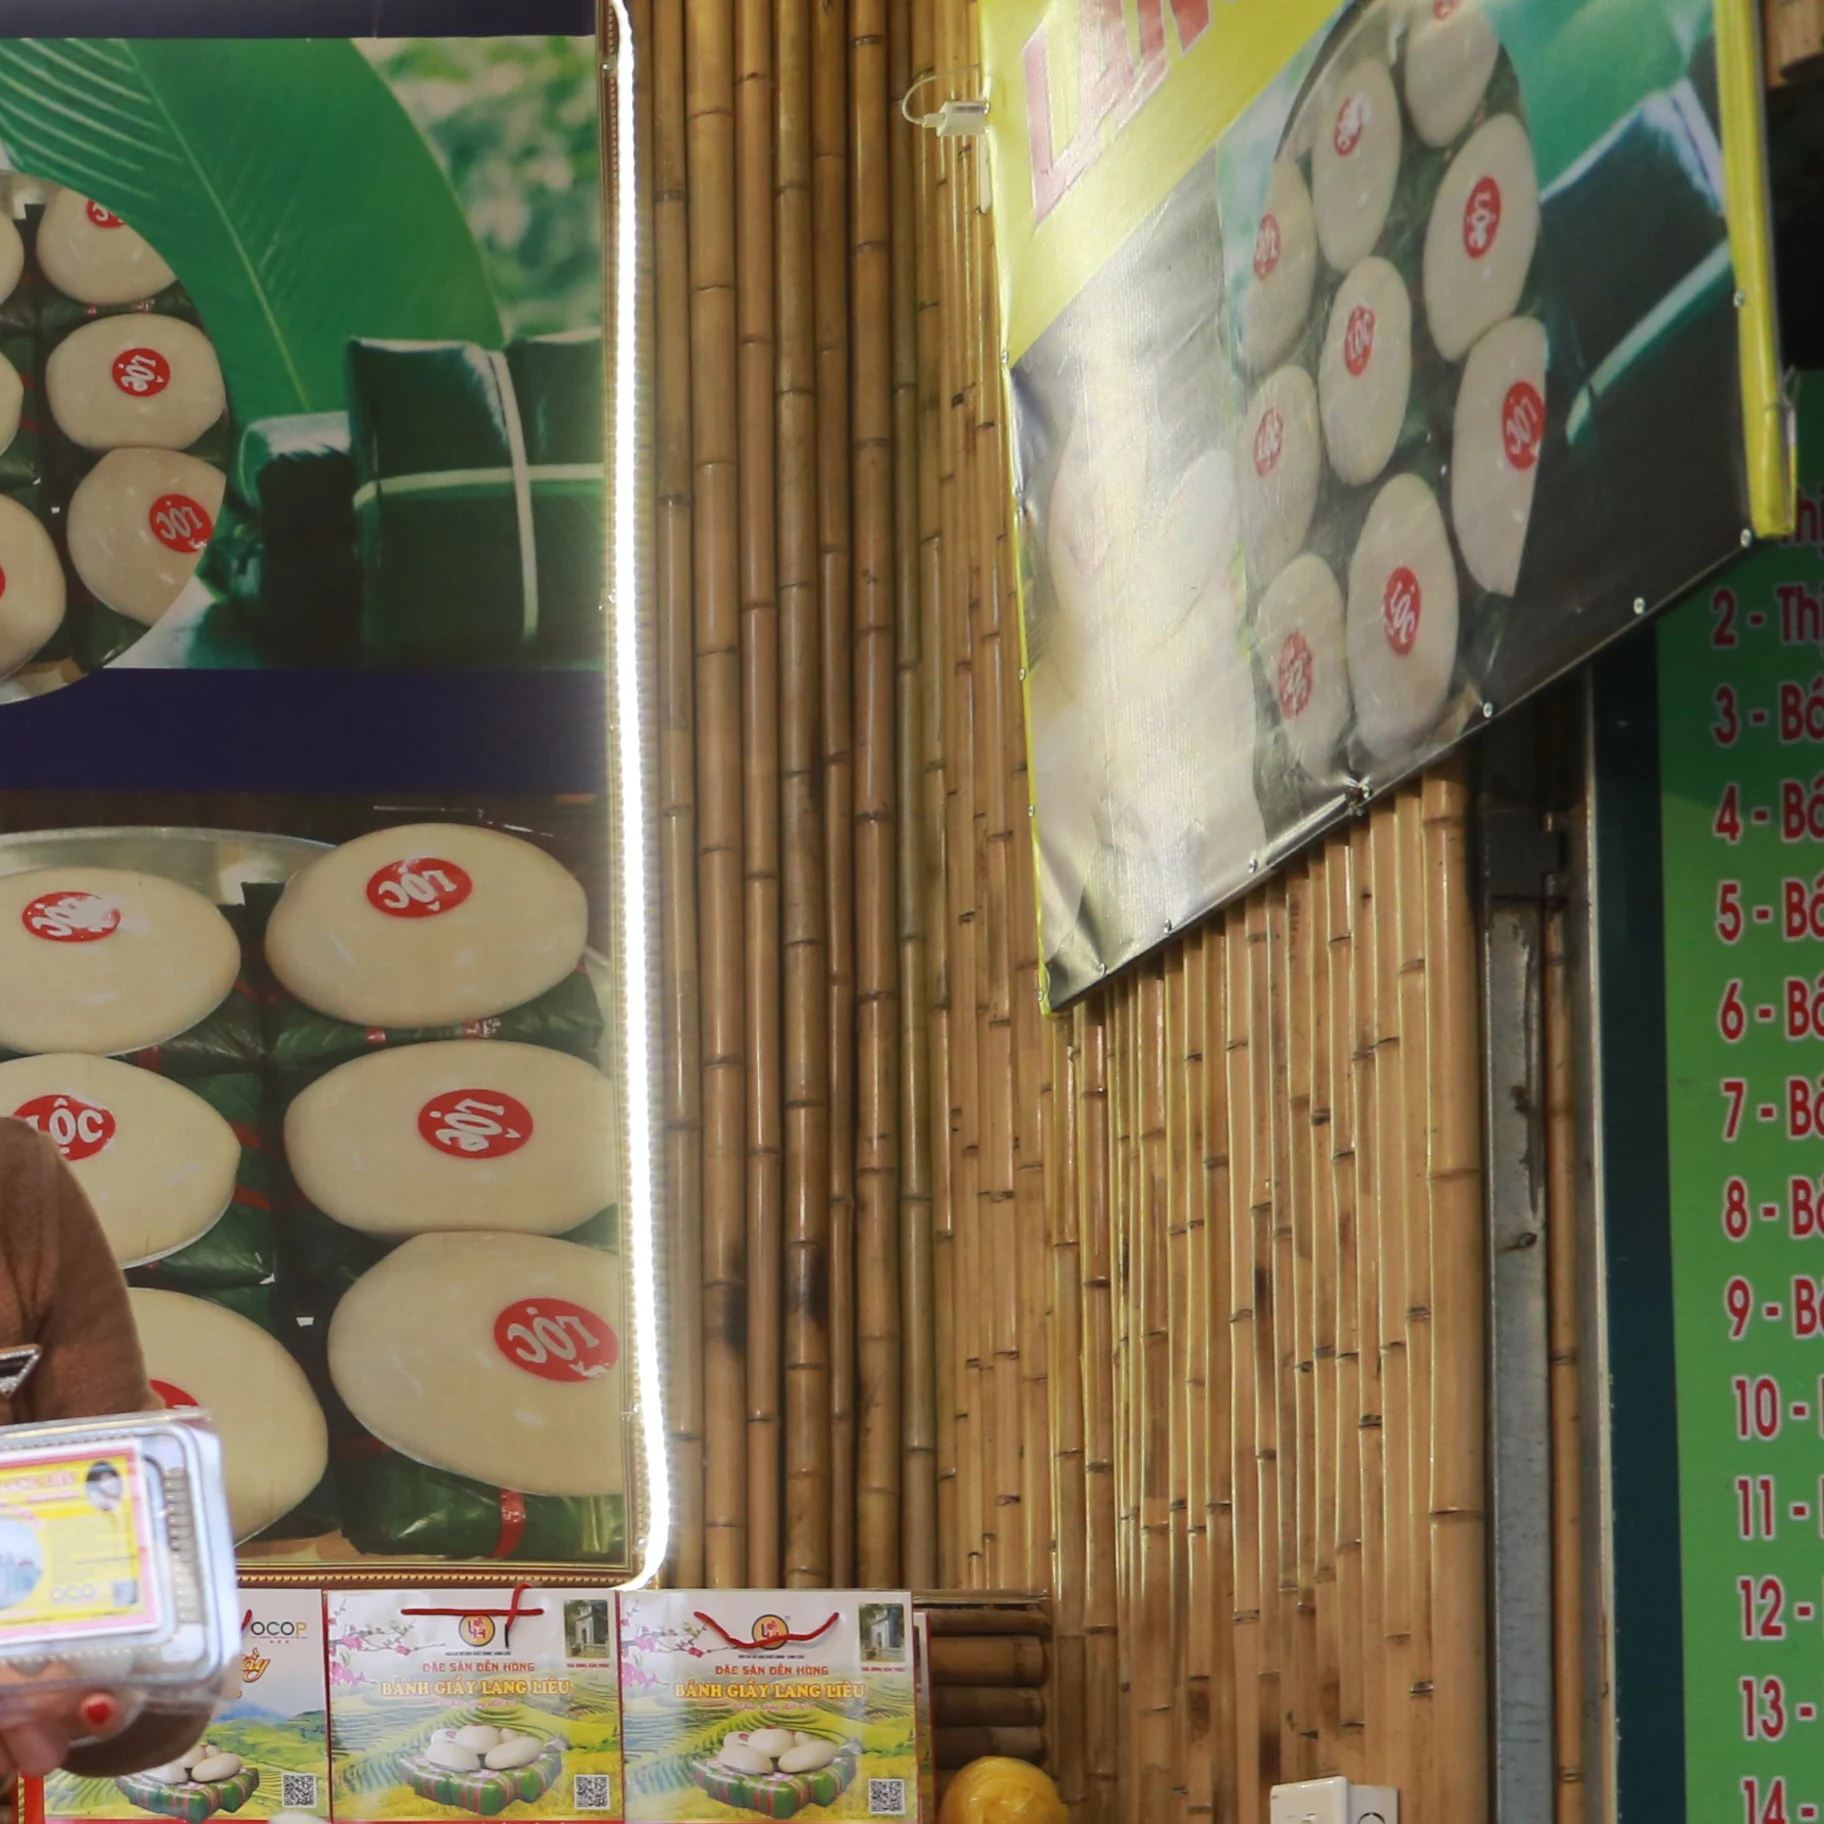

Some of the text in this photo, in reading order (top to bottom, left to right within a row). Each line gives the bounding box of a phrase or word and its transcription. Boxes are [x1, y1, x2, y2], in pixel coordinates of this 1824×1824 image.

[1711, 588, 1738, 647] 2
[1713, 685, 1739, 744] 3
[1715, 784, 1743, 842] 4
[378, 860, 458, 915] LỘC
[1718, 882, 1744, 942] 5
[1720, 980, 1746, 1042] 6
[1723, 1080, 1747, 1139] 7
[1725, 1178, 1750, 1239] 8
[1727, 1278, 1752, 1337] 9
[1735, 1378, 1779, 1438] 10
[1737, 1478, 1774, 1537] 11
[251, 1620, 308, 1636] OCOP
[1739, 1578, 1784, 1638] 12
[675, 1677, 865, 1698] BÁNH GIẦY LANG LIÊU
[1742, 1678, 1786, 1739] 13
